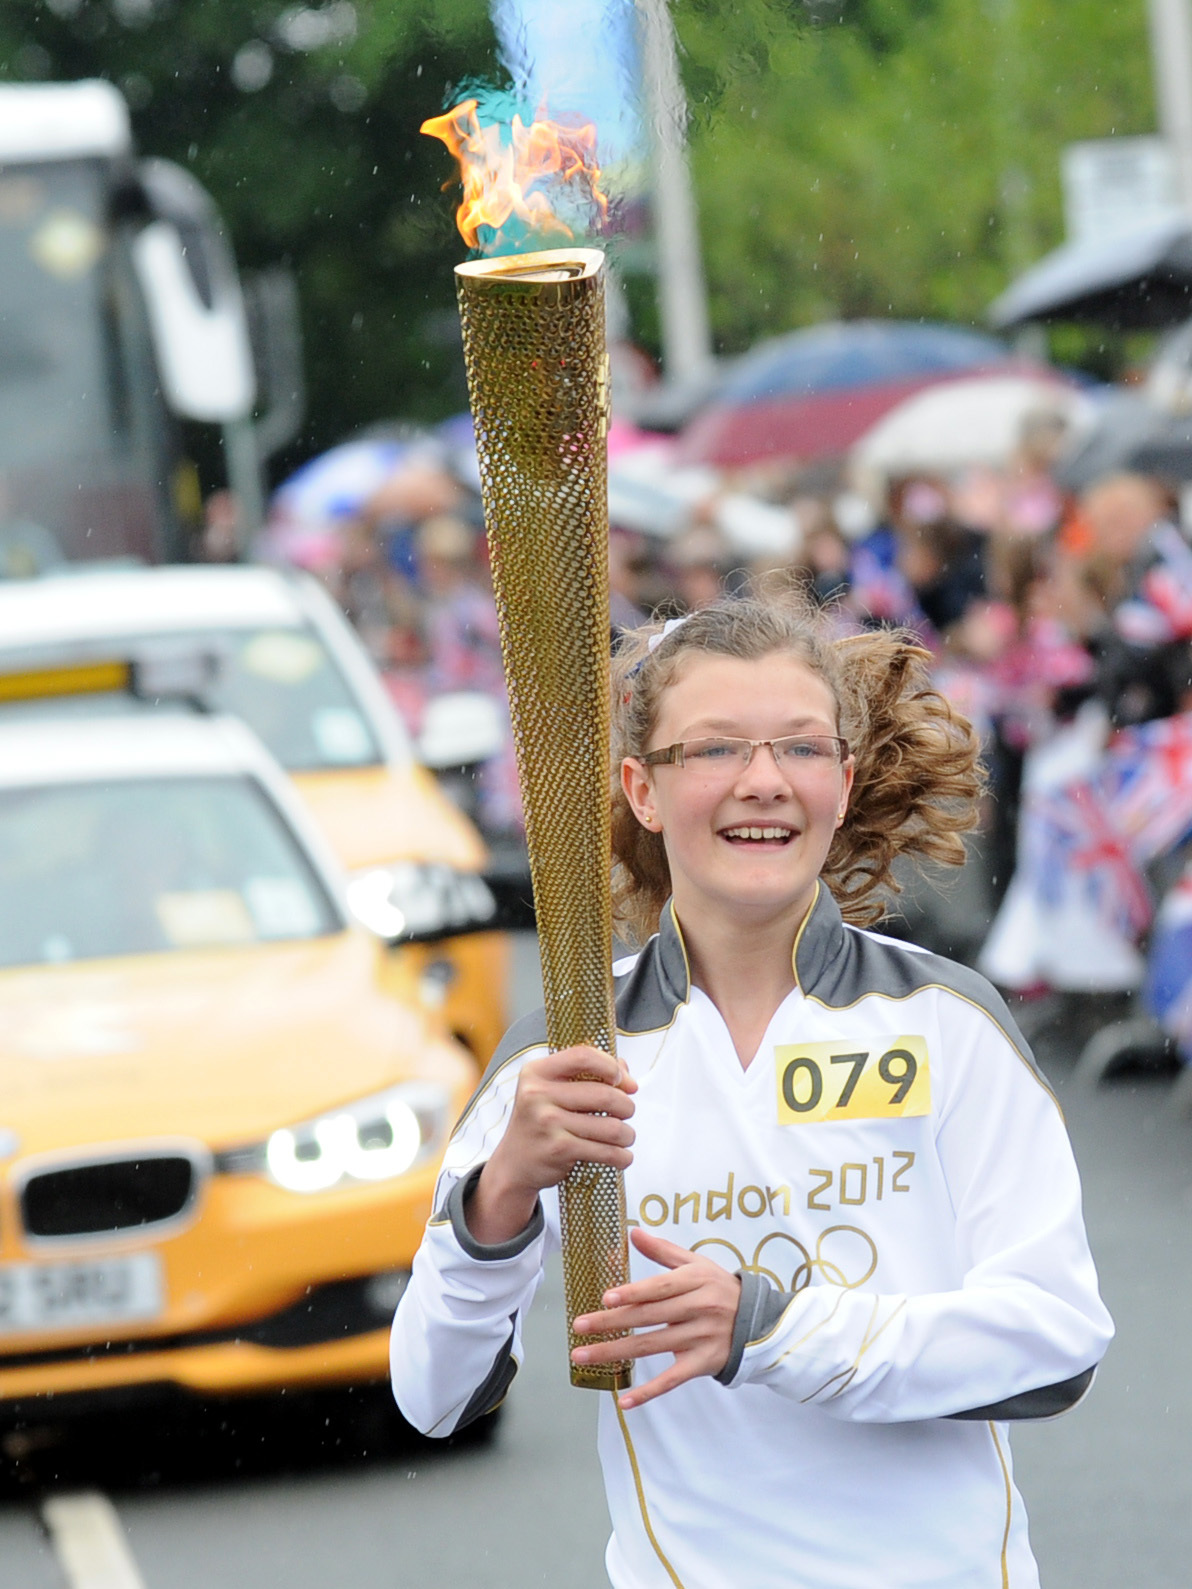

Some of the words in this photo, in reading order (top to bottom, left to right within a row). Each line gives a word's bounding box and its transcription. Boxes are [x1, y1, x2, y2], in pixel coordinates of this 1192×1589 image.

[782, 1049, 917, 1113] 079
[627, 1172, 791, 1227] ondon
[808, 1151, 915, 1211] 2012
